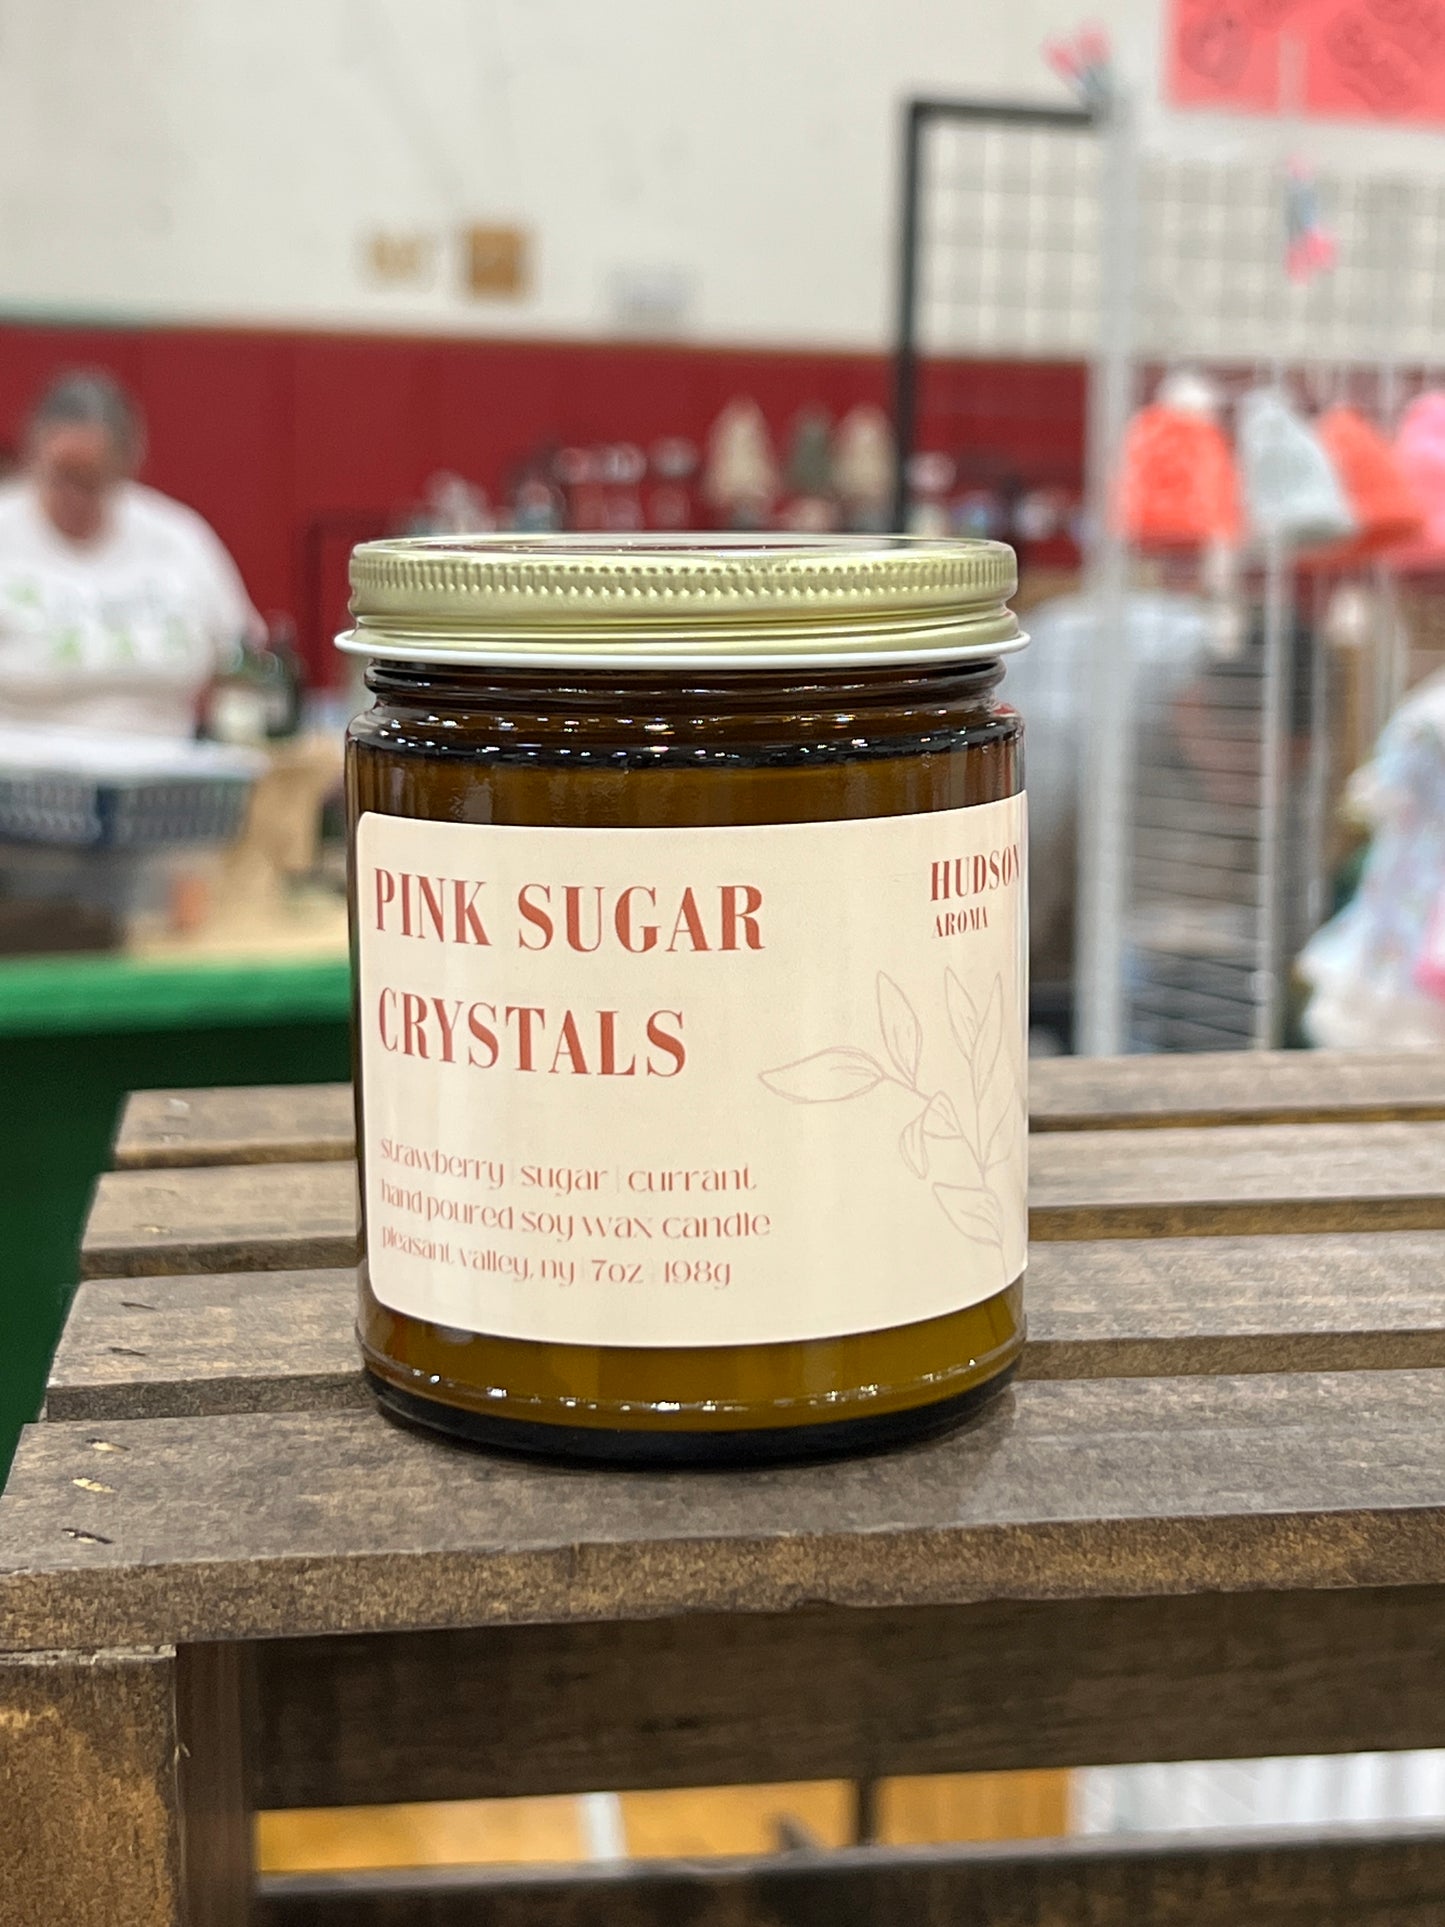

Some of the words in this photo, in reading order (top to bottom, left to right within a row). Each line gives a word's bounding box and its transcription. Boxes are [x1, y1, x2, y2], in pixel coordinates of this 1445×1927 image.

[374, 867, 492, 947] PINK
[518, 883, 766, 954] SUGAR
[931, 905, 989, 939] AROMA
[377, 986, 687, 1078] CRYSTALS
[379, 1136, 506, 1192] strawberry
[520, 1163, 609, 1198] sugar
[627, 1162, 759, 1193] currant
[380, 1178, 423, 1215] hand
[426, 1195, 514, 1231] poured
[520, 1210, 575, 1243] soy
[581, 1214, 654, 1240] wax
[662, 1210, 772, 1241] candle
[381, 1225, 456, 1267] pleasant
[458, 1244, 535, 1283] valley,
[539, 1258, 576, 1289] ny
[591, 1258, 645, 1285] 7oz
[664, 1258, 732, 1291] 198g
